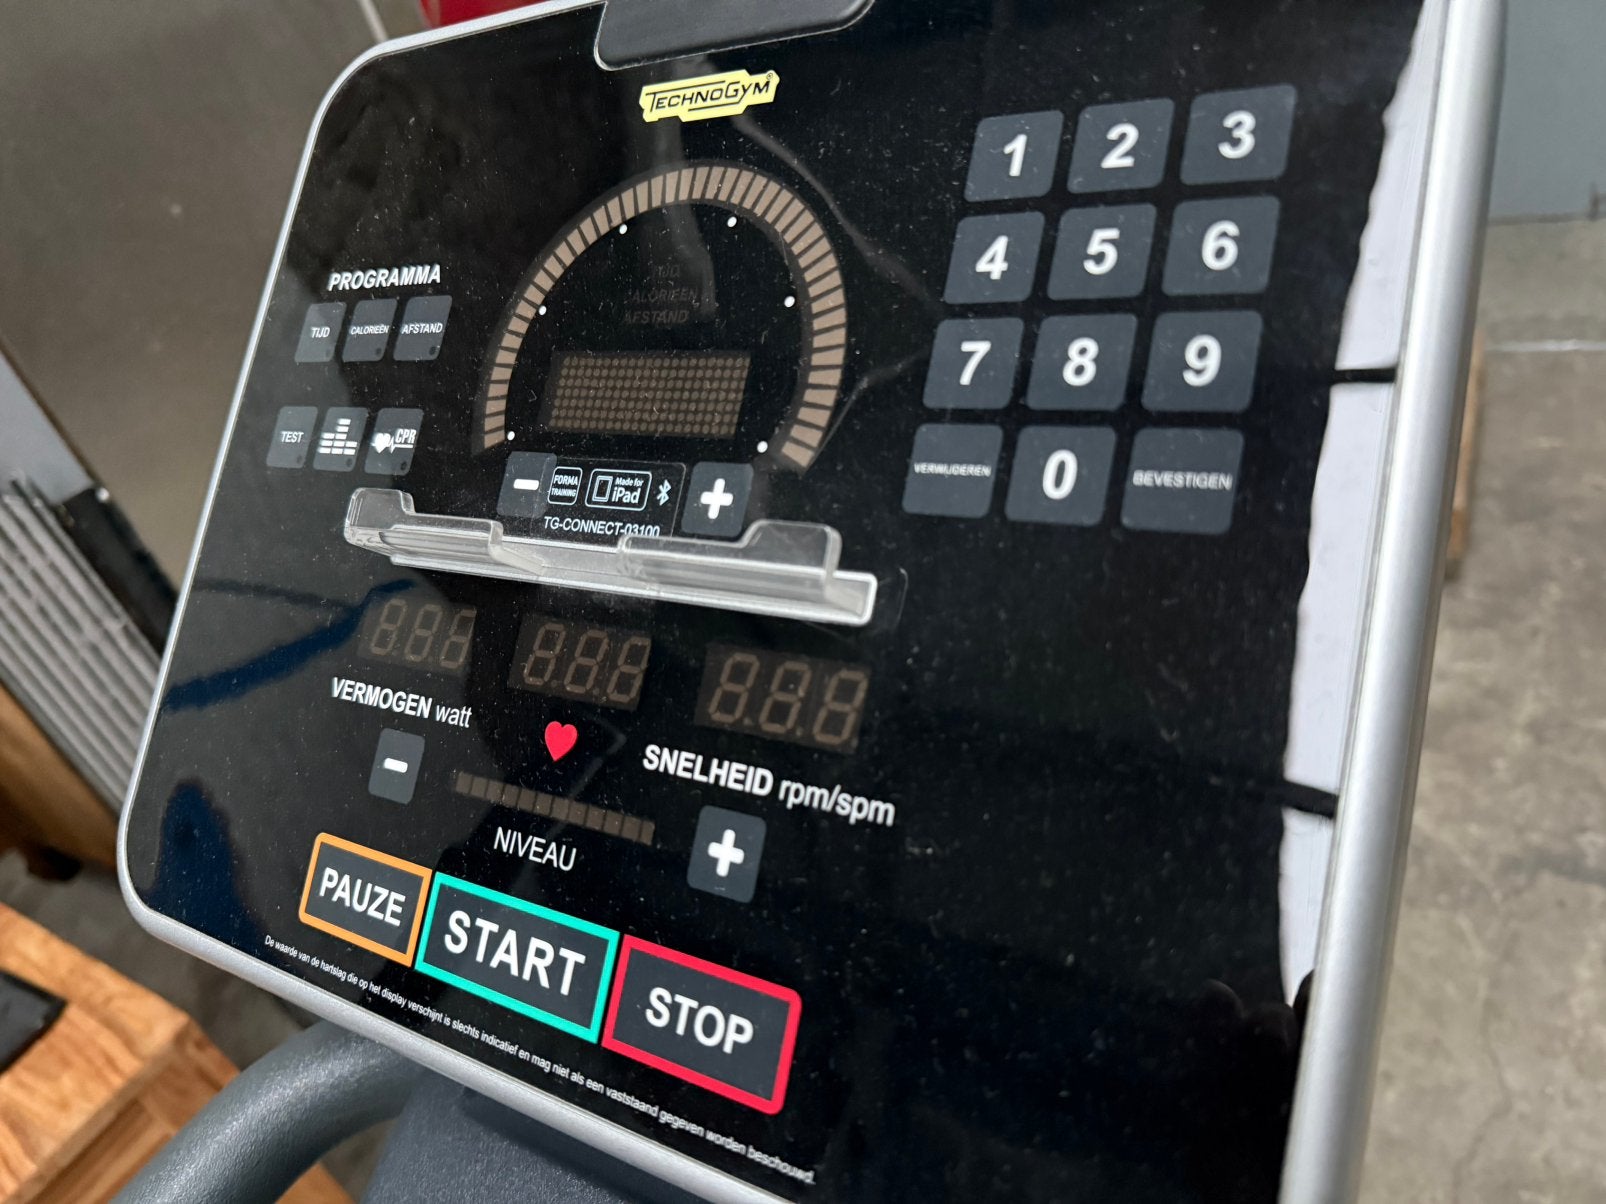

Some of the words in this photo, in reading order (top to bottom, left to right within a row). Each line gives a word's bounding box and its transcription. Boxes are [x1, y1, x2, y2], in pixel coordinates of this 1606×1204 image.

[1003, 134, 1028, 177] 1
[1100, 123, 1139, 169] 2
[1218, 110, 1257, 159] 3
[975, 235, 1009, 280] 4
[1083, 228, 1120, 275] 5
[1201, 220, 1240, 270] 6
[327, 264, 442, 291] PROGRAMMA
[310, 326, 330, 338] TIJD
[401, 323, 443, 334] AFSTAND
[959, 340, 991, 385] 7
[1062, 337, 1099, 386] 8
[1182, 334, 1222, 387] 9
[280, 431, 304, 443] TEST
[395, 428, 417, 444] CPR
[553, 474, 578, 486] FORMA
[615, 477, 634, 487] Made
[635, 478, 644, 487] for
[914, 462, 992, 477] VERWIJDEREN
[1042, 449, 1078, 500] 0
[1133, 470, 1233, 491] BEVESTIGEN
[551, 488, 577, 498] TRAINING
[612, 487, 641, 504] iPad
[331, 676, 433, 720] VERMOGEN
[435, 705, 473, 729] watt
[643, 743, 773, 797] SNELHEID
[778, 777, 896, 828] rpm/spm
[494, 827, 577, 872] NIVEAU
[319, 867, 406, 928] PAUZE
[444, 910, 587, 997] START
[645, 987, 754, 1054] STOP
[265, 935, 275, 946] De
[275, 941, 298, 958] waarde
[298, 951, 310, 964] van
[310, 956, 320, 968] de
[320, 959, 346, 981] hartslag
[347, 973, 358, 985] die
[358, 979, 368, 990] op
[369, 980, 381, 995] het
[381, 987, 407, 1008] display
[408, 999, 443, 1023] verschijnt
[443, 1015, 451, 1026] is
[452, 1018, 480, 1039] slechts
[480, 1030, 519, 1056] indicatief
[518, 1049, 530, 1061] en
[531, 1055, 551, 1074] mag
[552, 1064, 570, 1079] niet
[570, 1070, 585, 1086] als
[586, 1078, 604, 1094] een
[606, 1086, 659, 1118] vaststaand
[658, 1109, 705, 1138] gegeven
[706, 1128, 747, 1156] worden
